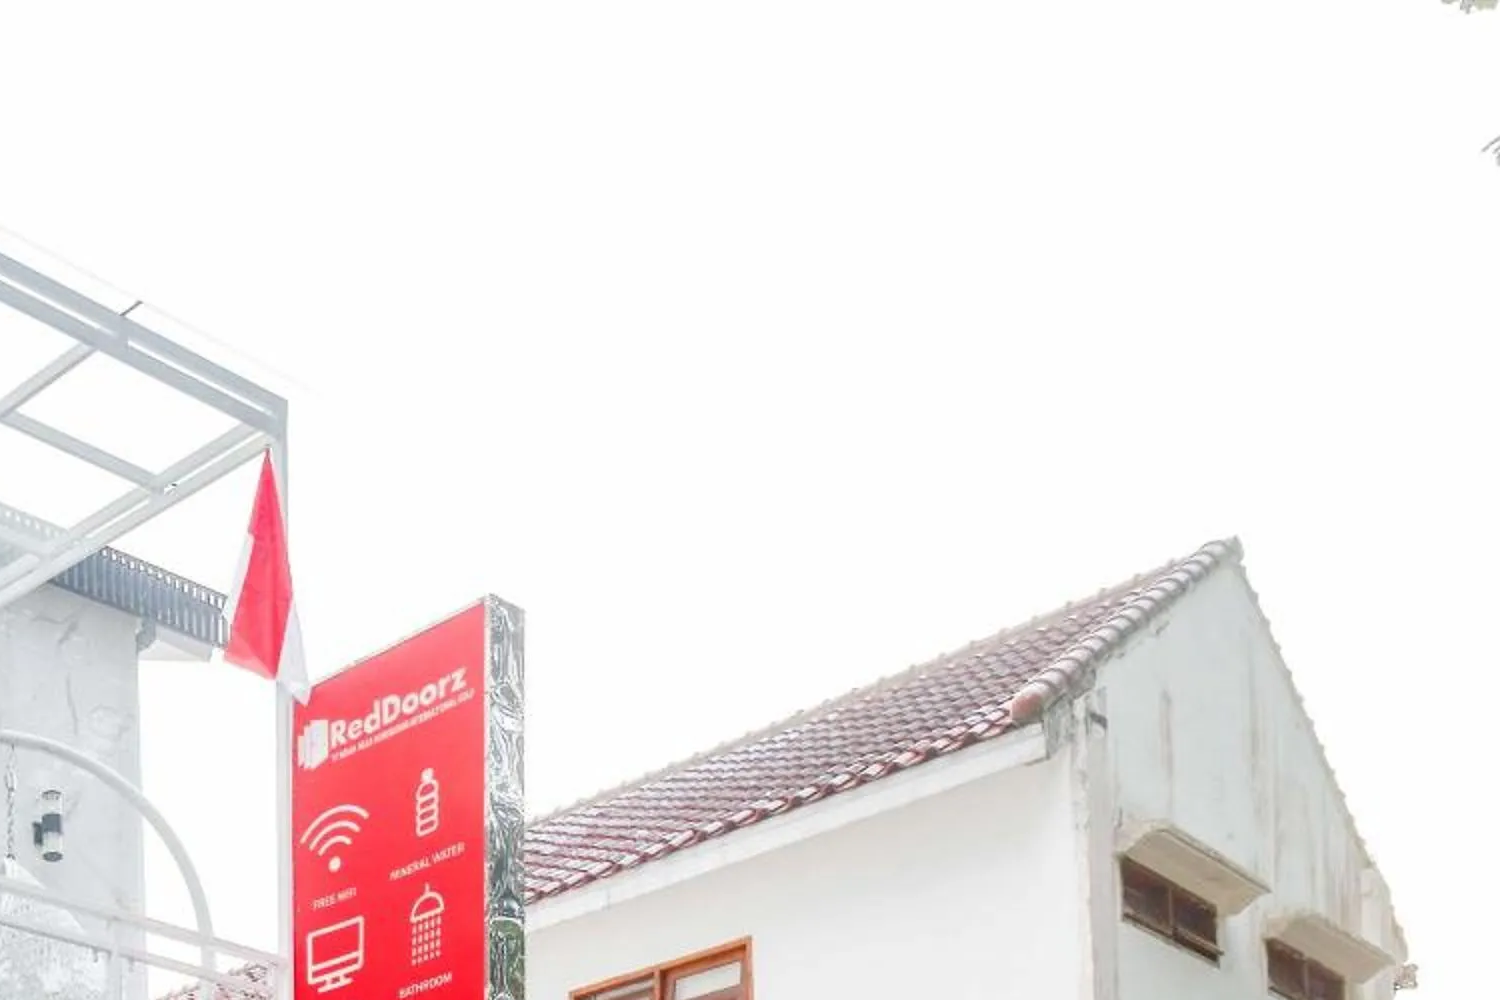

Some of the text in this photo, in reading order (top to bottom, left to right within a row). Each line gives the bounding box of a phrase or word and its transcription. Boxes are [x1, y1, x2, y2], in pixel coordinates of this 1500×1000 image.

[330, 666, 468, 749] RedDoorz
[389, 841, 465, 881] MINERAL WATER
[311, 892, 336, 911] FREE
[398, 971, 452, 999] BATHROOM
